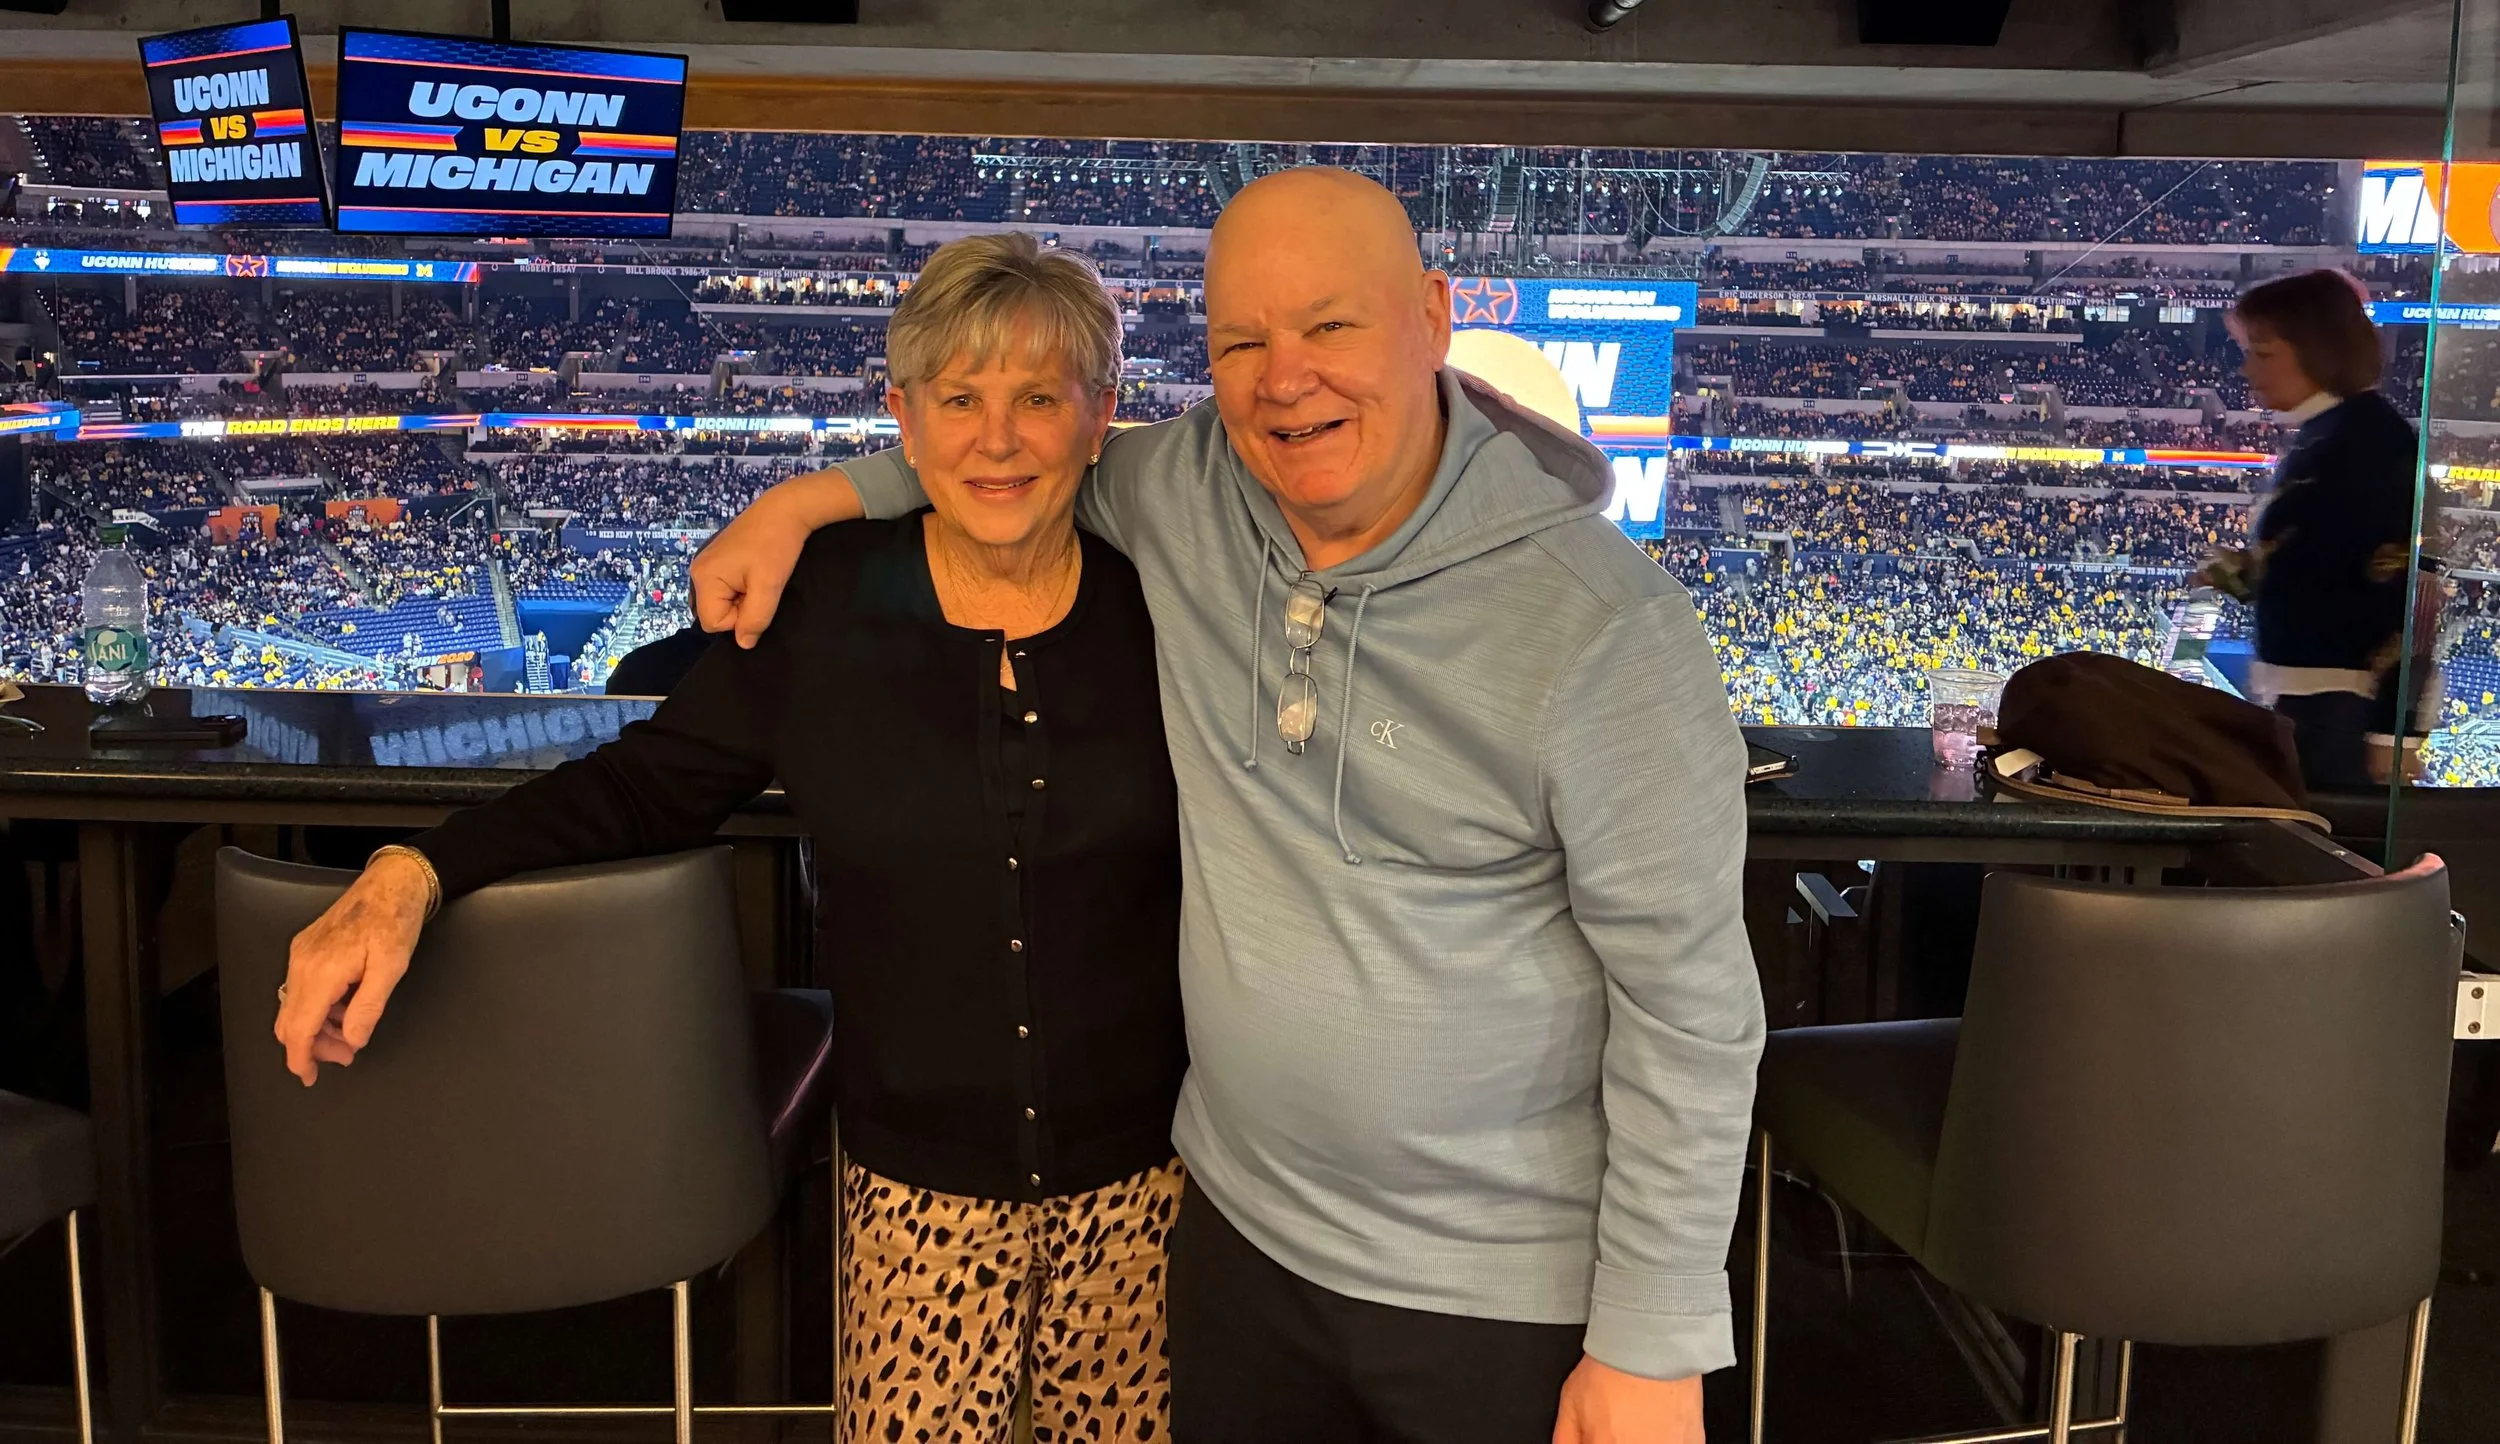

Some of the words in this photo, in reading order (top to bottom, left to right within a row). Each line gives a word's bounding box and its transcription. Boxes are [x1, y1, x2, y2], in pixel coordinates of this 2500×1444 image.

[173, 68, 270, 113] UCONN
[408, 81, 625, 127] UCONN
[210, 115, 247, 140] VS
[484, 128, 560, 154] VS
[169, 142, 302, 183] MICHIGAN
[353, 152, 655, 195] MICHIGAN
[81, 255, 142, 269] UCONN
[520, 265, 550, 273] ROBERT
[553, 266, 577, 274] IRSAY
[626, 266, 644, 275] BILL
[646, 267, 677, 276] BROOKS
[758, 270, 782, 278] CHRIS
[784, 271, 813, 279] HINTON
[1719, 291, 1737, 299] ERIC
[1739, 292, 1784, 300] DICKERSON
[1865, 294, 1907, 302] MARSHALL
[1909, 294, 1935, 303] FAULK
[2018, 297, 2038, 305] JEFF
[2040, 297, 2081, 306] SATURDAY
[2189, 300, 2223, 309] POLIAN
[226, 419, 288, 435] ROAD
[289, 418, 345, 433] ENDS
[347, 416, 400, 431] HERE
[694, 417, 747, 431] UCONN
[1730, 438, 1782, 453] UCONN
